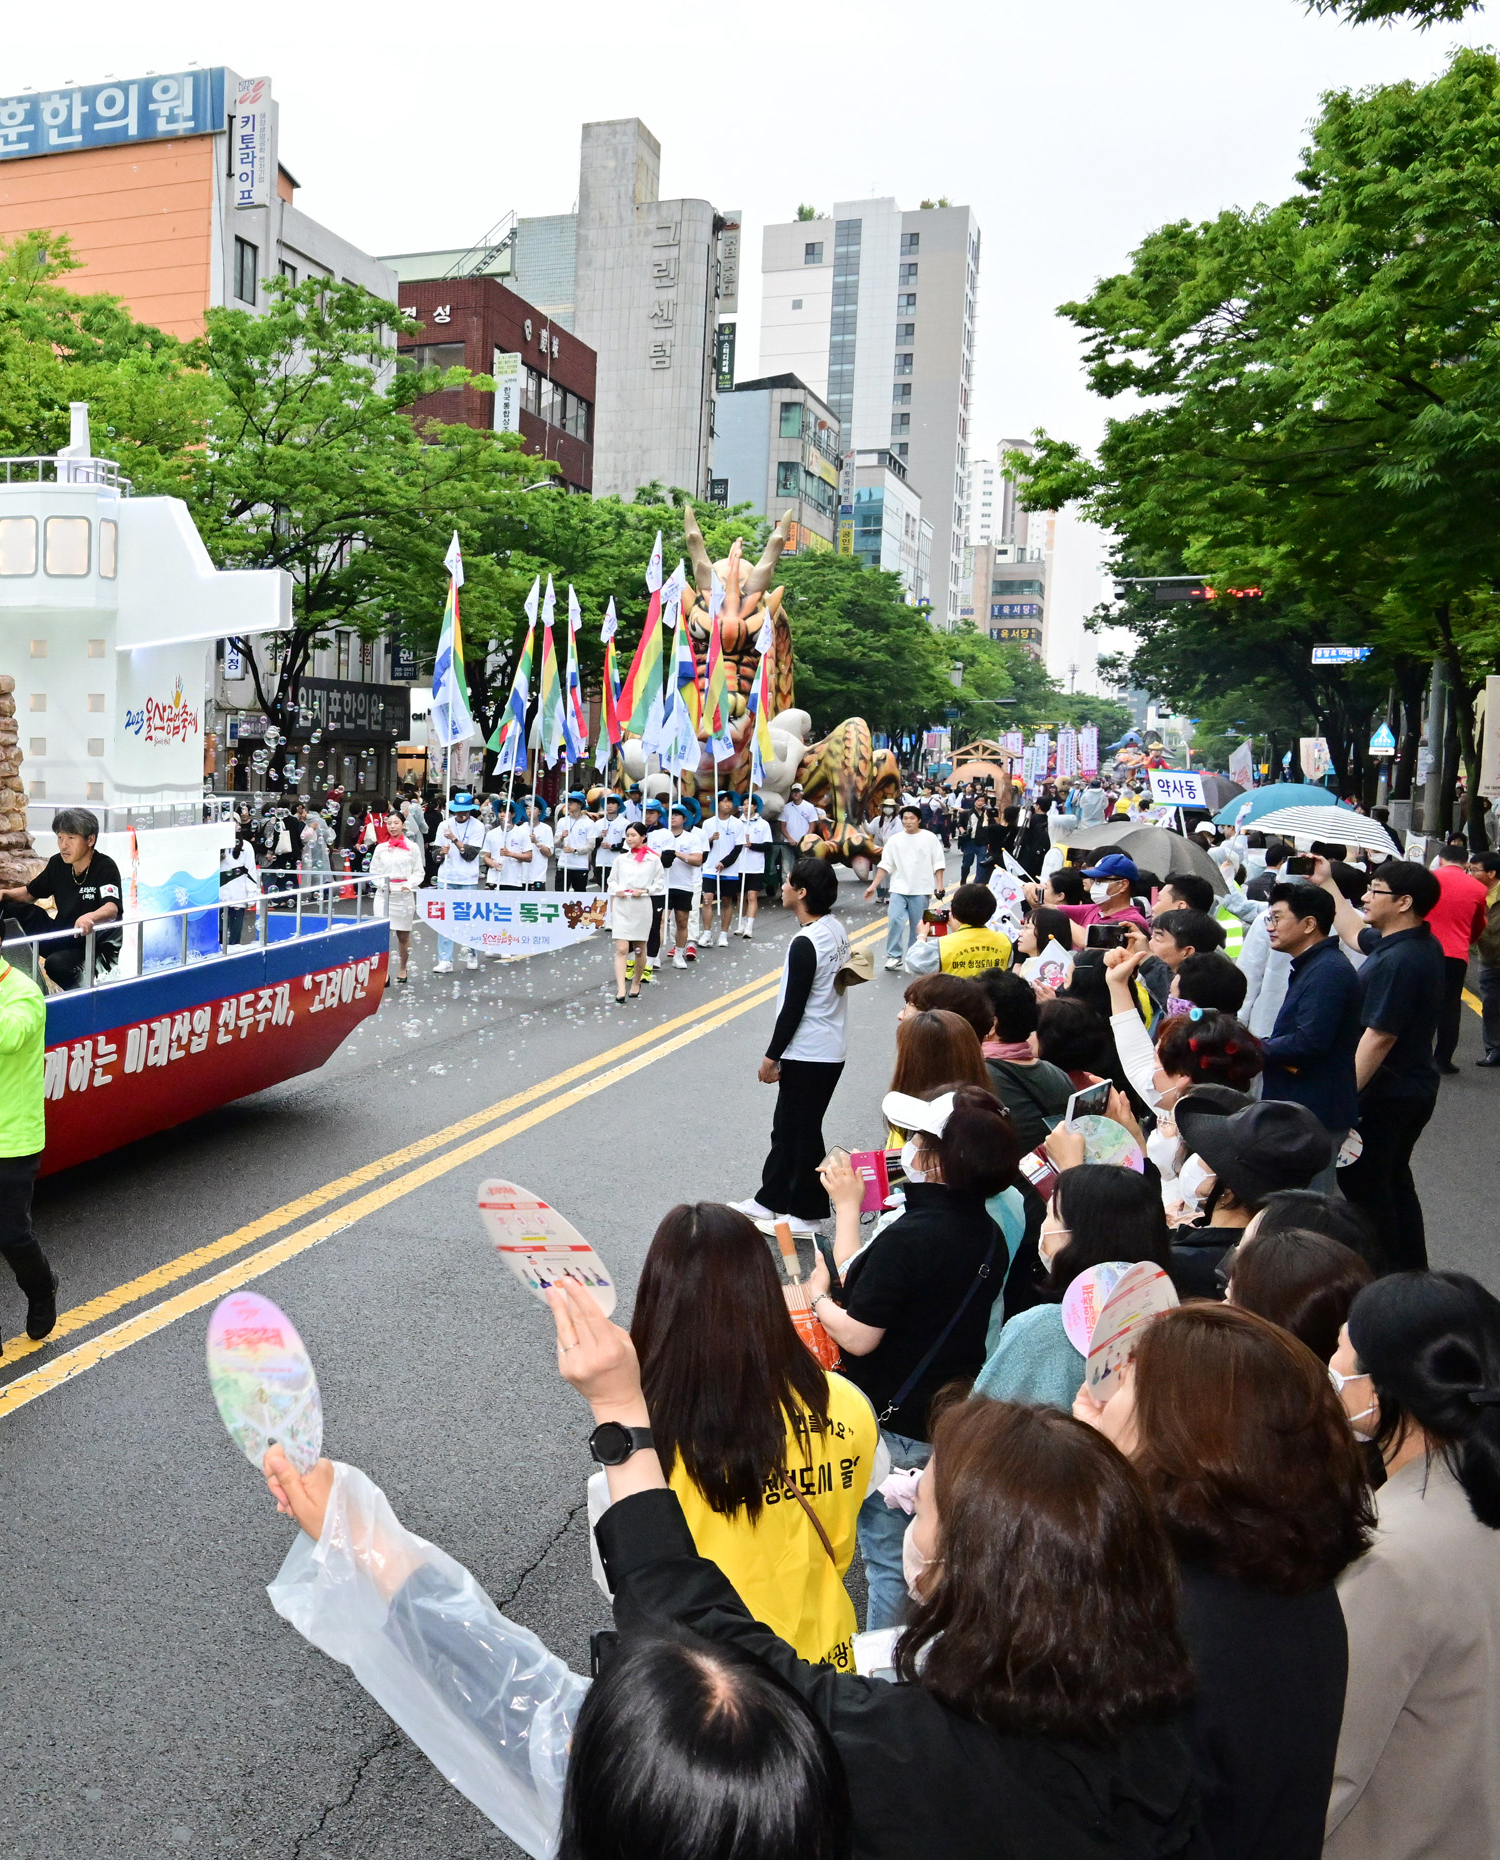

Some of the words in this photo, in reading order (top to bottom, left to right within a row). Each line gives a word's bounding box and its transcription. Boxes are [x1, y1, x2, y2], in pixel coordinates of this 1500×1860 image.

[237, 114, 257, 206] 키토라이프
[648, 222, 680, 370] 그린센텀
[125, 710, 145, 736] 2023
[145, 697, 199, 743] 울산공업축제
[298, 686, 383, 731] 임재훈한의원
[1157, 778, 1197, 800] 약사동
[427, 900, 446, 921] 더
[452, 901, 513, 923] 잘사는
[519, 903, 561, 924] 동구
[521, 936, 530, 945] 와
[532, 935, 551, 945] 함께
[952, 961, 966, 970] 마약
[967, 960, 993, 969] 청정도시
[43, 1034, 118, 1101] 께하는
[124, 1012, 211, 1074] 미래산업
